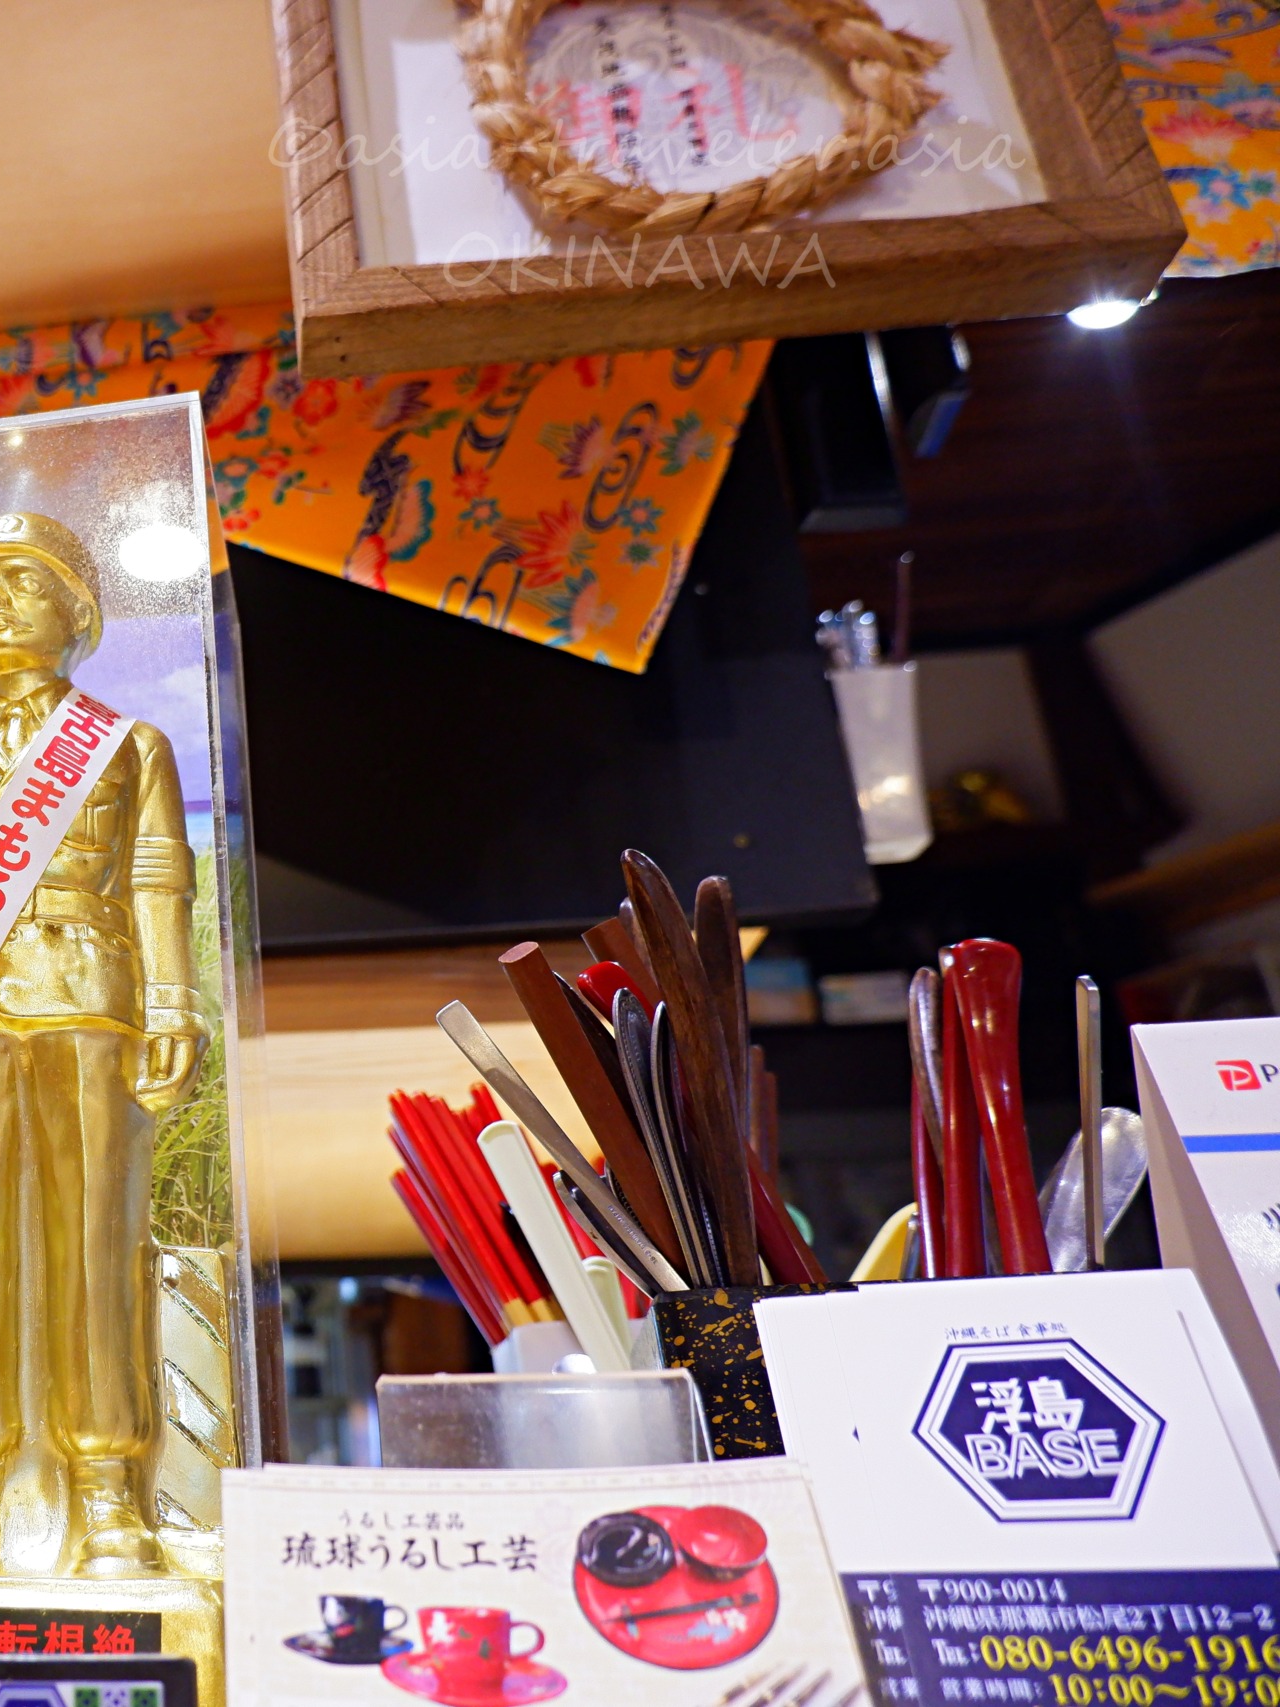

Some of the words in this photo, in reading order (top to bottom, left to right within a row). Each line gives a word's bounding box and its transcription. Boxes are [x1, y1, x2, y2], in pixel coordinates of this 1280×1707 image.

[970, 1376, 1084, 1434] 浮島
[964, 1428, 1124, 1479] BASE
[281, 1532, 538, 1571] 琉球うるし工芸
